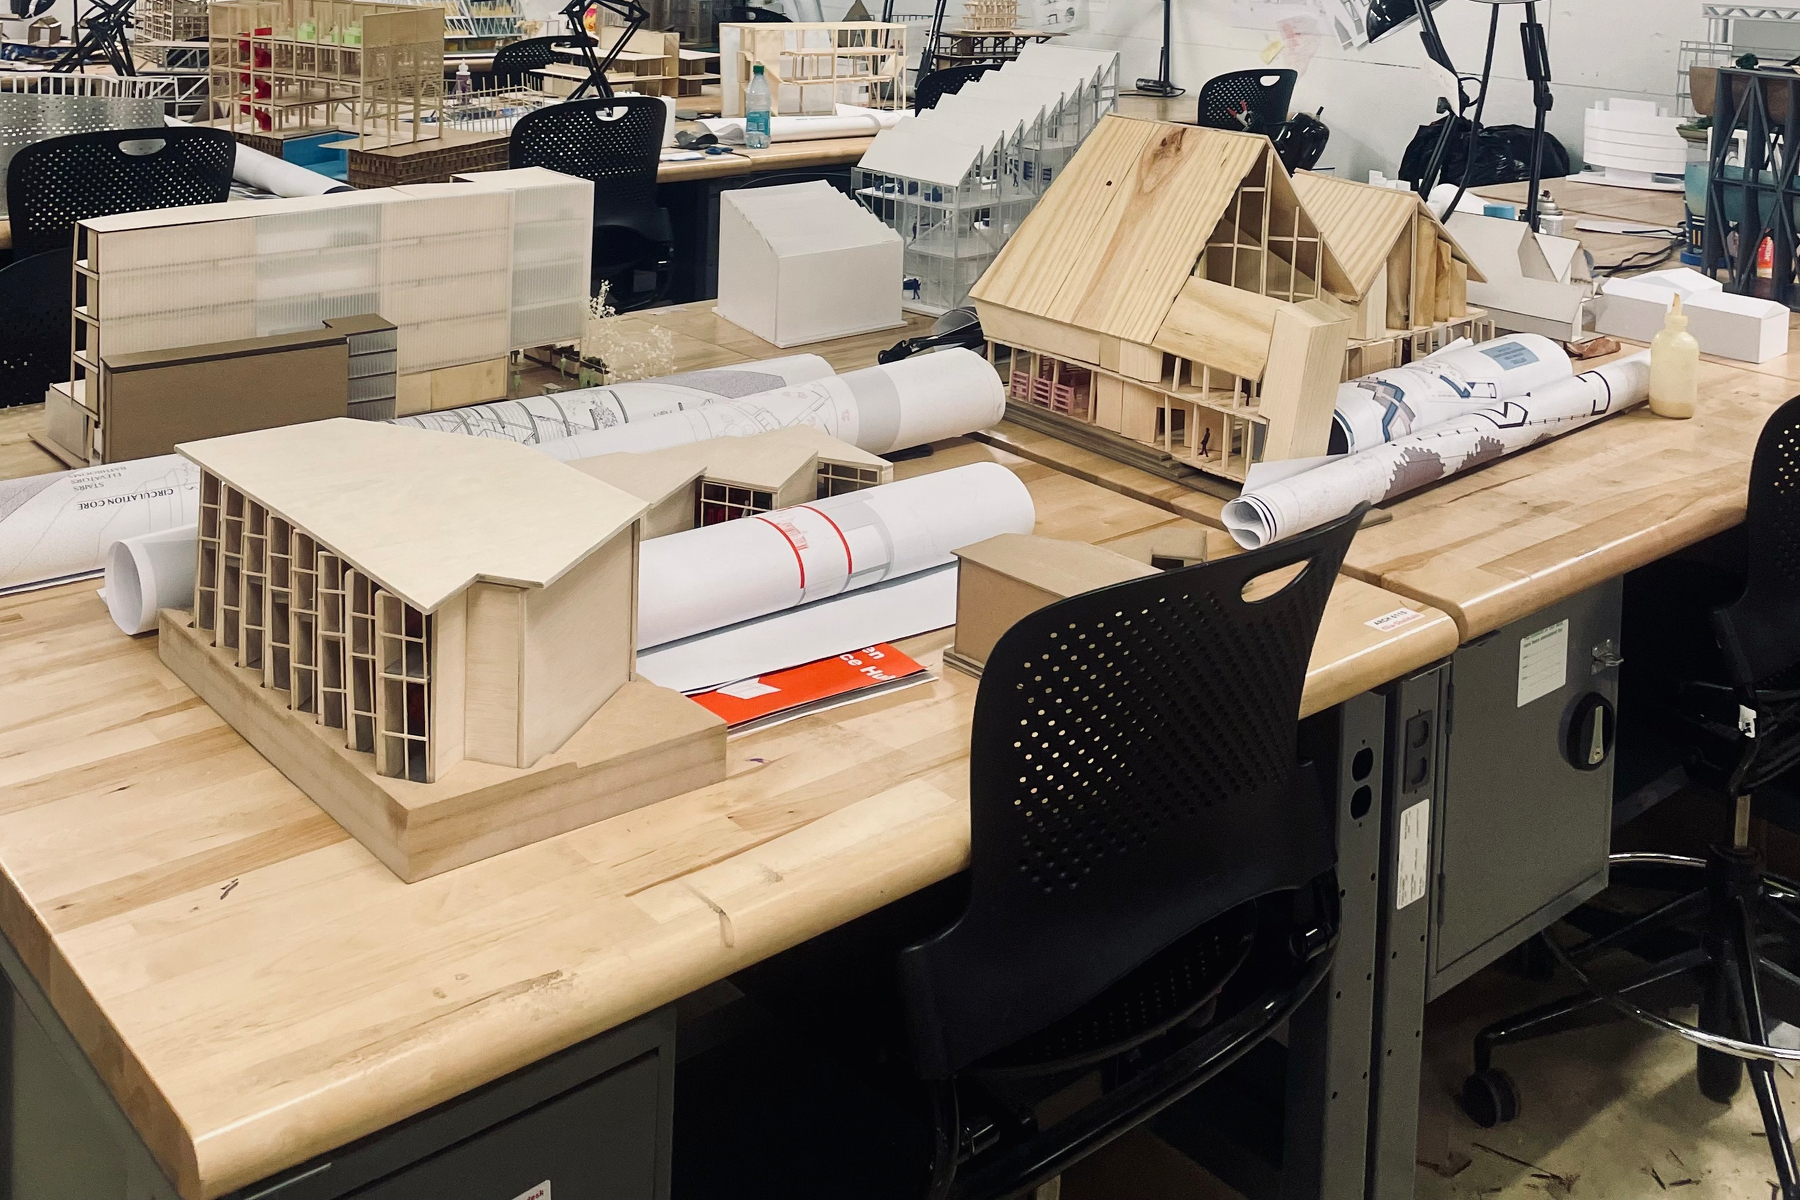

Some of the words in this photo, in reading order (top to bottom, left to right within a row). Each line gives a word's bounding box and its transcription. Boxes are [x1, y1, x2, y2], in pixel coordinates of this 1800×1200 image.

[70, 472, 122, 485] ELEVATORS
[72, 482, 105, 492] STAIRS
[107, 488, 174, 506] CIRCULATION
[77, 499, 106, 511] CORE
[839, 653, 863, 666] ce
[861, 646, 885, 660] en
